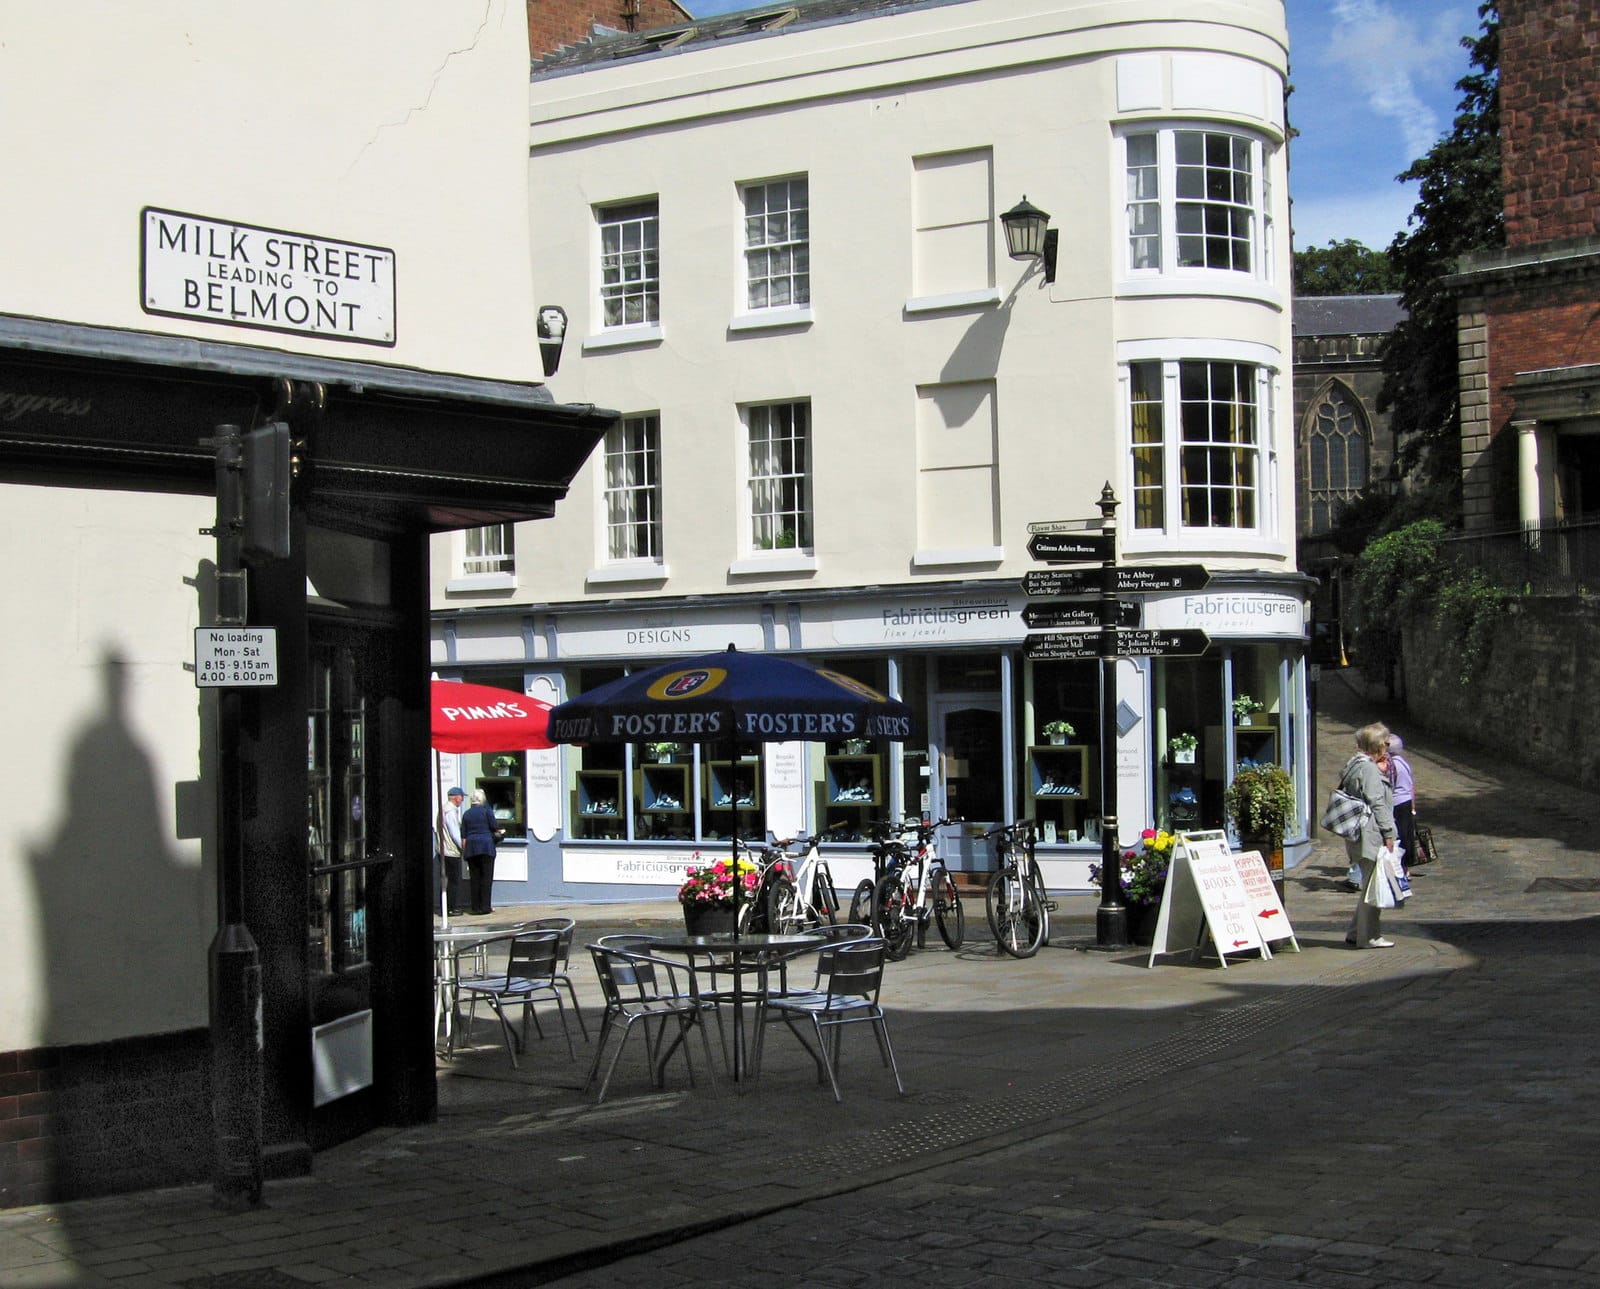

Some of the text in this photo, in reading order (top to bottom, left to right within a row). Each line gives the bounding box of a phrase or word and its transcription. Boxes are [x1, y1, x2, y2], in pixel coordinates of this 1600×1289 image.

[159, 219, 383, 283] MILK STREET
[207, 261, 338, 296] LEADING TO
[184, 278, 361, 332] BELMONT
[1028, 572, 1050, 580] Railway
[1117, 571, 1155, 580] The Abbey
[1040, 579, 1061, 587] Station
[1117, 580, 1140, 589] Abbey
[1140, 580, 1170, 589] Foregate
[1184, 596, 1297, 617] Fabriciusgreen
[1071, 610, 1093, 619] Gallery
[210, 632, 263, 644] No loading
[627, 628, 692, 644] DESIGNS
[1056, 633, 1083, 643] Shopping
[1117, 631, 1134, 640] Wyle
[1135, 631, 1150, 640] Cop
[214, 647, 235, 657] Mon
[243, 647, 260, 657] Sat
[1050, 649, 1077, 659] Shopping
[1117, 647, 1164, 656] English Bridge
[204, 660, 226, 670] 8.15
[233, 660, 254, 670] 9.15
[200, 672, 226, 681] 4.00
[233, 671, 257, 681] 6.00
[259, 674, 274, 682] pm
[441, 702, 528, 721] PIMM'S
[611, 711, 721, 736] FOSTER'S
[745, 712, 856, 734] FOSTER'S
[1203, 876, 1237, 891] BOOKS
[1226, 923, 1245, 936] CDs
